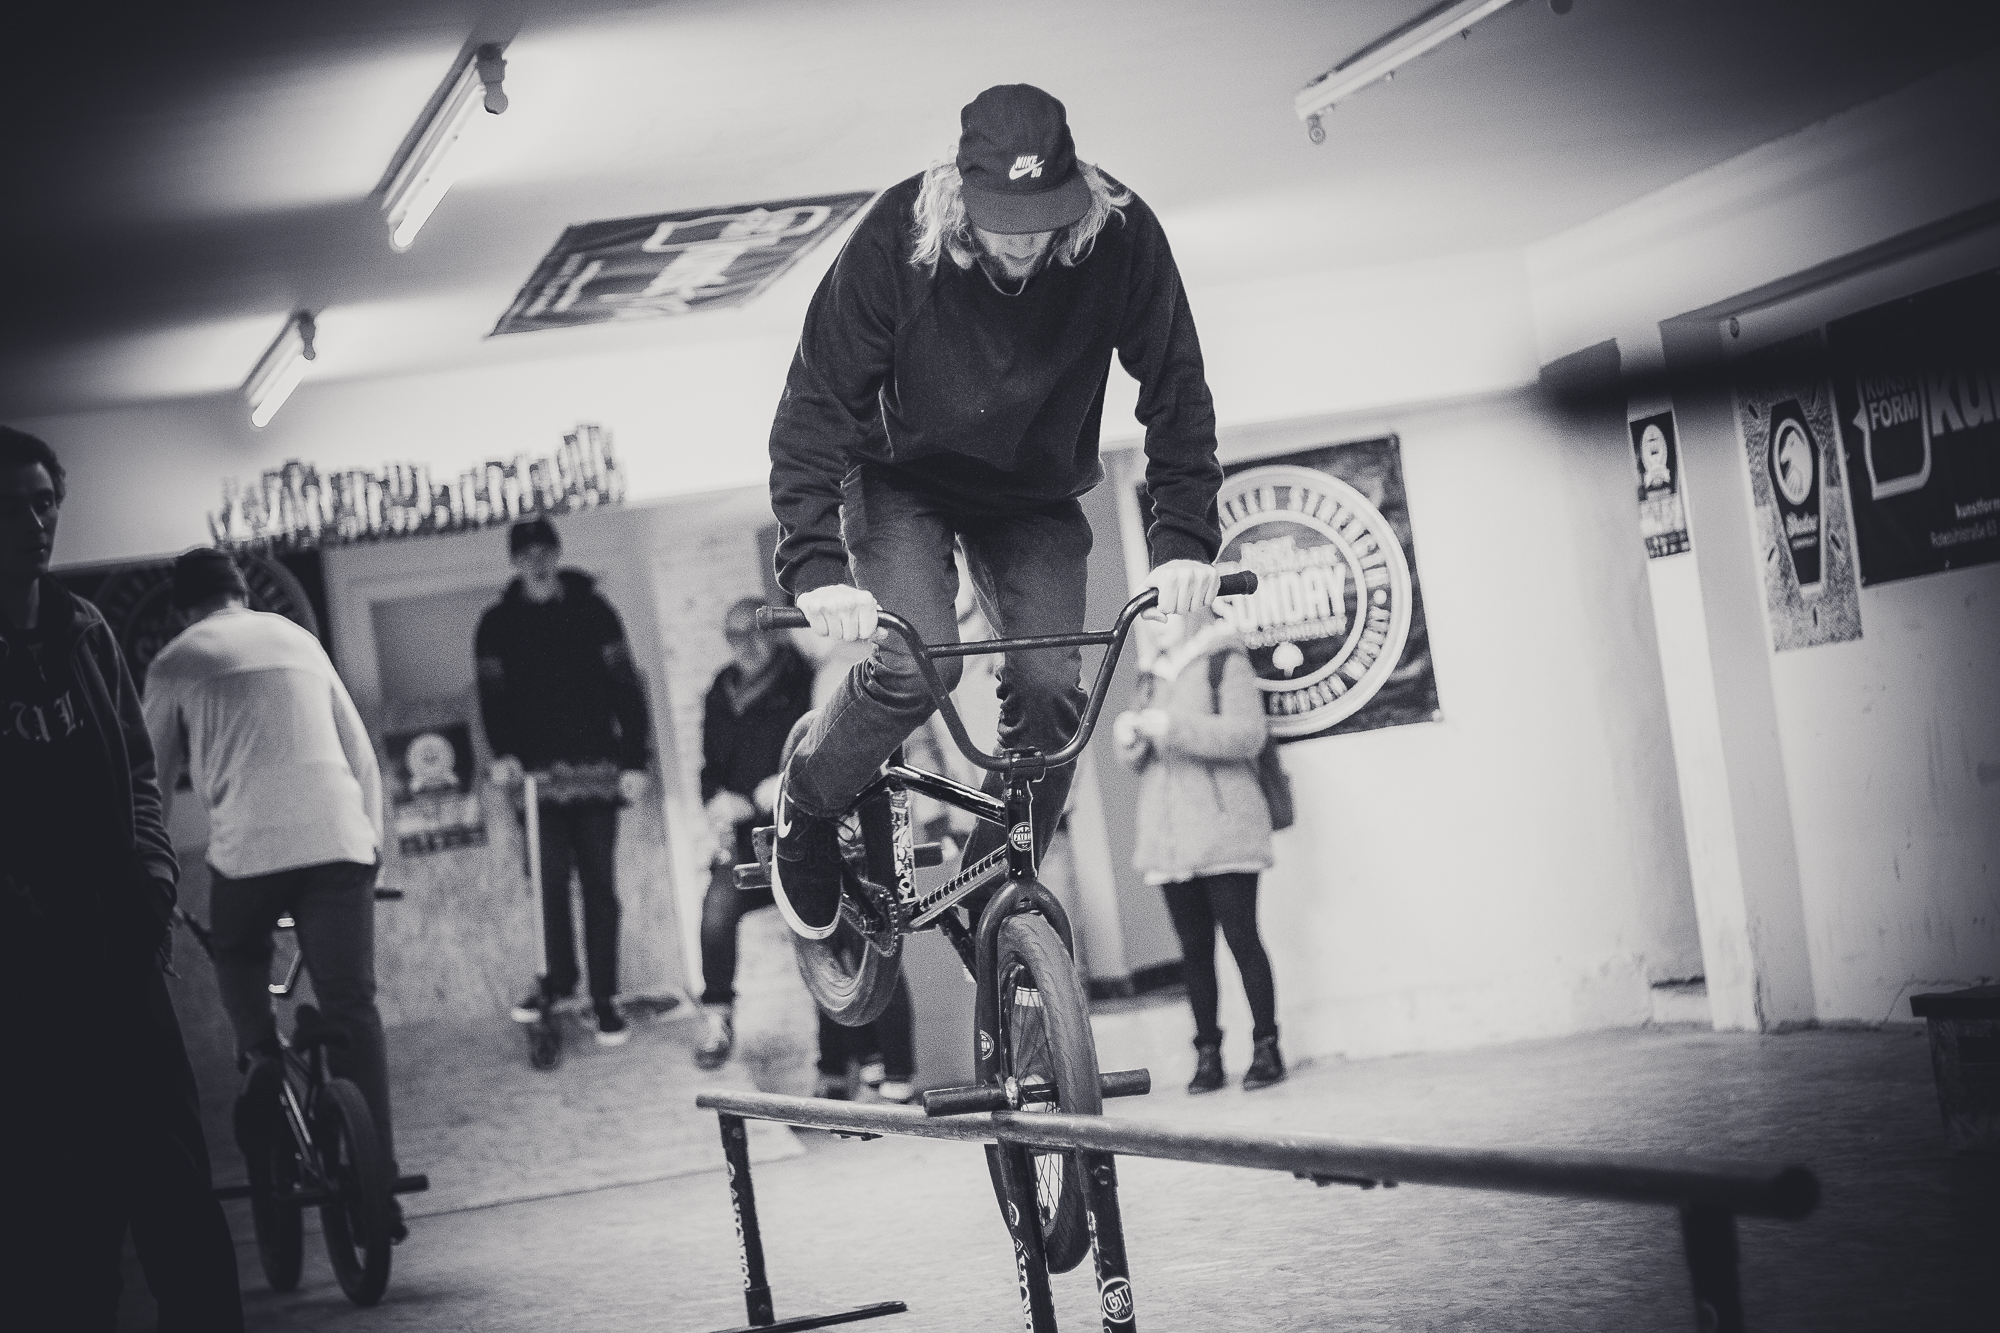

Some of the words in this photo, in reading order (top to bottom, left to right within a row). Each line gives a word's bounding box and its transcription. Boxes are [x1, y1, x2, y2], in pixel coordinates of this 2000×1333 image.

[1015, 154, 1039, 170] NIKE
[1869, 390, 1919, 431] FORM
[1211, 562, 1346, 634] SUNDAY
[1103, 1285, 1131, 1313] GT
